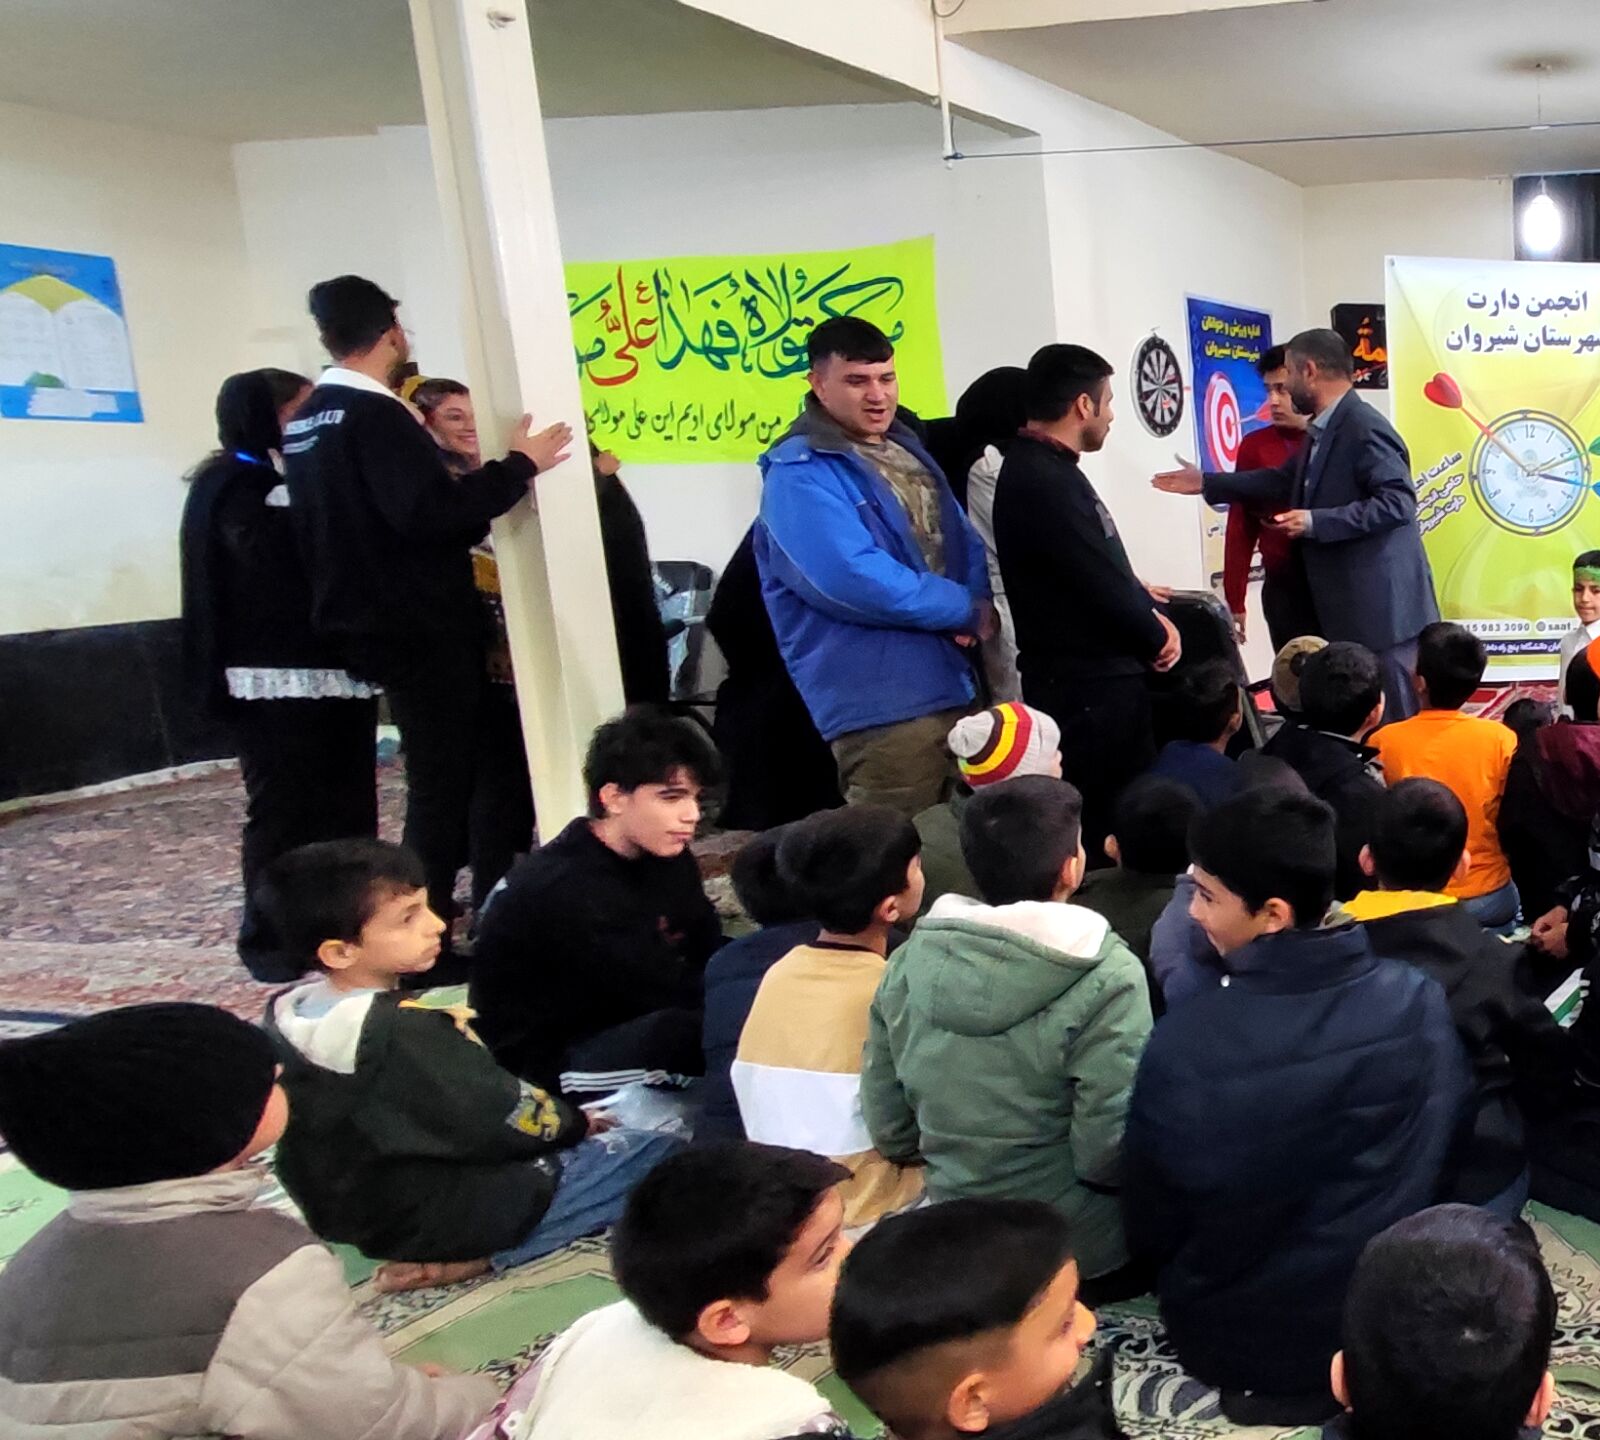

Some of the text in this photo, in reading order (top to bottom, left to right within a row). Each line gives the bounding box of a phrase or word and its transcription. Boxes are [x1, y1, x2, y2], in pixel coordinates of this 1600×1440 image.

[1467, 288, 1588, 317] انجمن دارت
[1446, 323, 1519, 351] شیروان
[1525, 424, 1535, 438] 12
[1560, 447, 1572, 458] 2
[1428, 452, 1462, 478] ساعت
[1528, 509, 1534, 523] 6
[1547, 504, 1556, 517] 5
